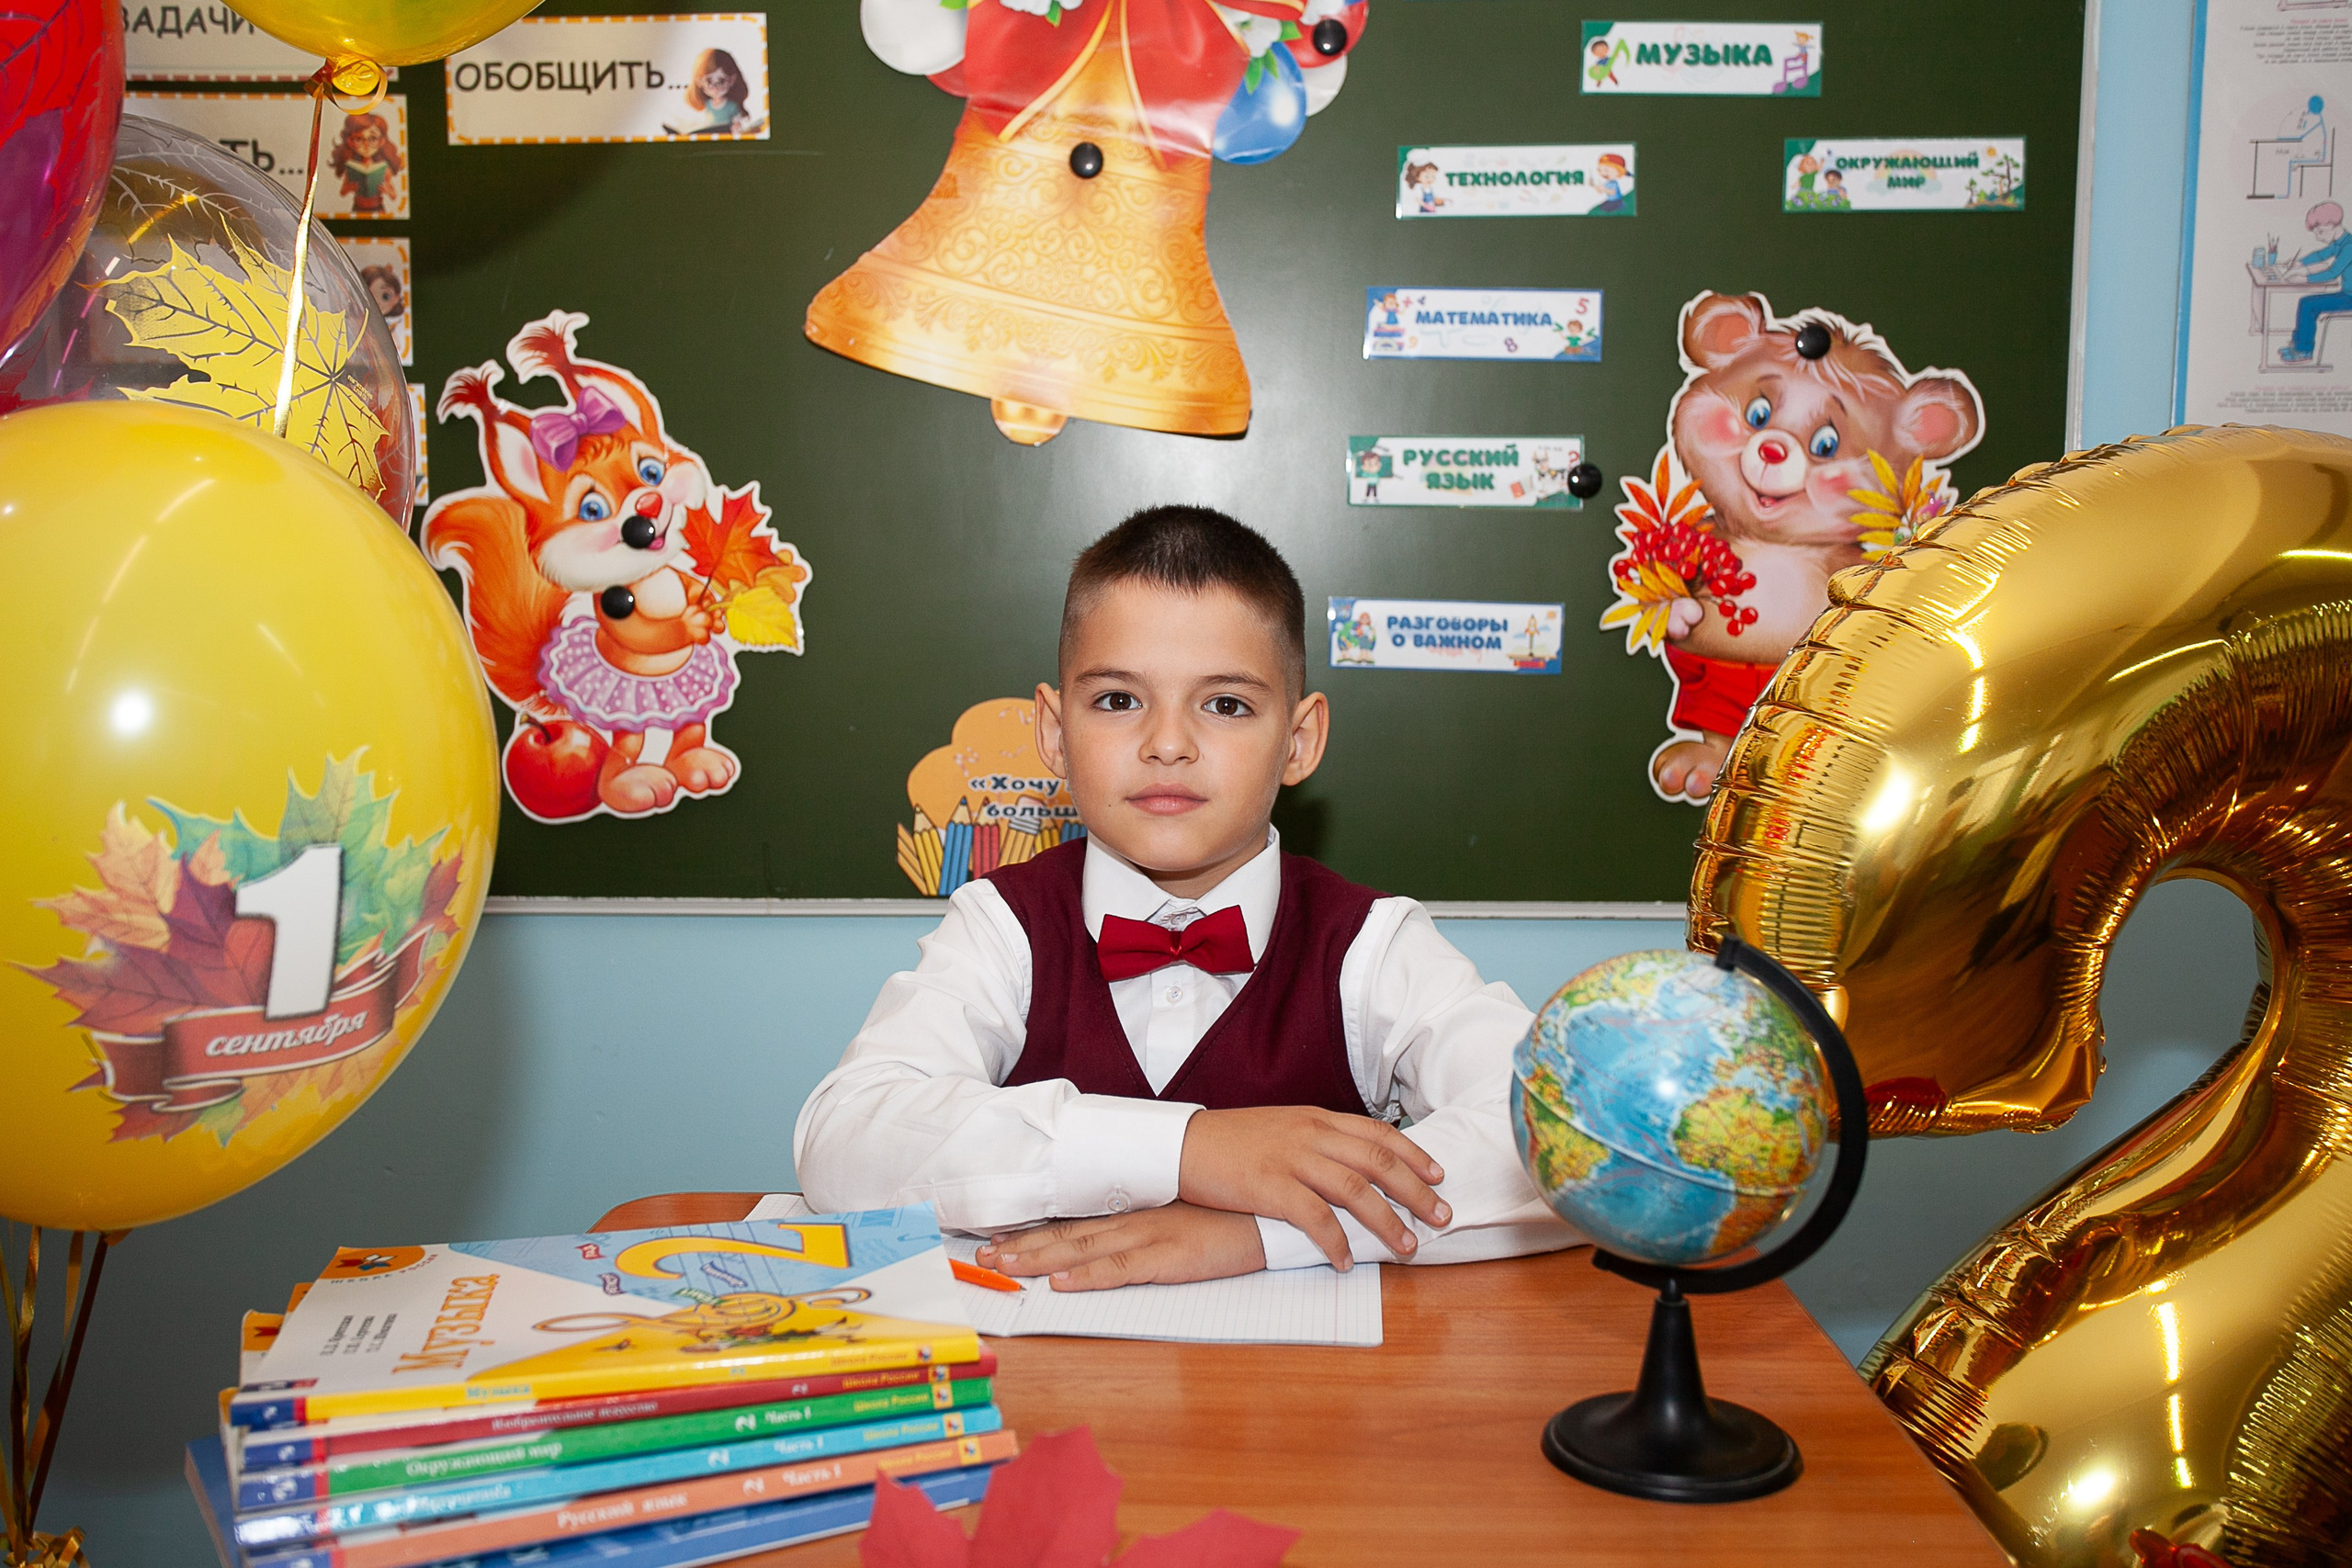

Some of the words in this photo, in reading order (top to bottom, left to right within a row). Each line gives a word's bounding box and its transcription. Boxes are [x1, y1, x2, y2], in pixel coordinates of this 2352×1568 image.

[1635, 42, 1773, 67] МУЗЫКА
[455, 60, 689, 96] ОБОБЩИТЬ...
[1835, 150, 1980, 171] ОКРУЖАЮЩИЙ
[1445, 170, 1585, 187] ТЕХНОЛОГИЯ
[1886, 175, 1927, 189] МИР
[1415, 310, 1554, 327] МАТЕМАТИКА
[1402, 443, 1520, 468] РУССКИЙ
[1426, 471, 1495, 491] ЯЗЫК
[1387, 615, 1509, 633] РАЗГОВОРЫ
[1391, 634, 1407, 648] О
[1412, 634, 1502, 650] ВАЖНОМ
[969, 776, 1060, 796] «Хочу
[987, 805, 1078, 818] больш
[235, 844, 344, 1021] 1
[205, 1011, 368, 1057] сентября
[616, 1223, 850, 1280] 2
[390, 1273, 502, 1375] Музыка
[406, 1445, 526, 1477] Окружающий
[527, 1442, 562, 1460] мир
[735, 1413, 757, 1432] 2
[764, 1410, 803, 1425] Часть
[707, 1448, 730, 1468] 2
[556, 1501, 634, 1529] Русский
[742, 1477, 765, 1496] 2
